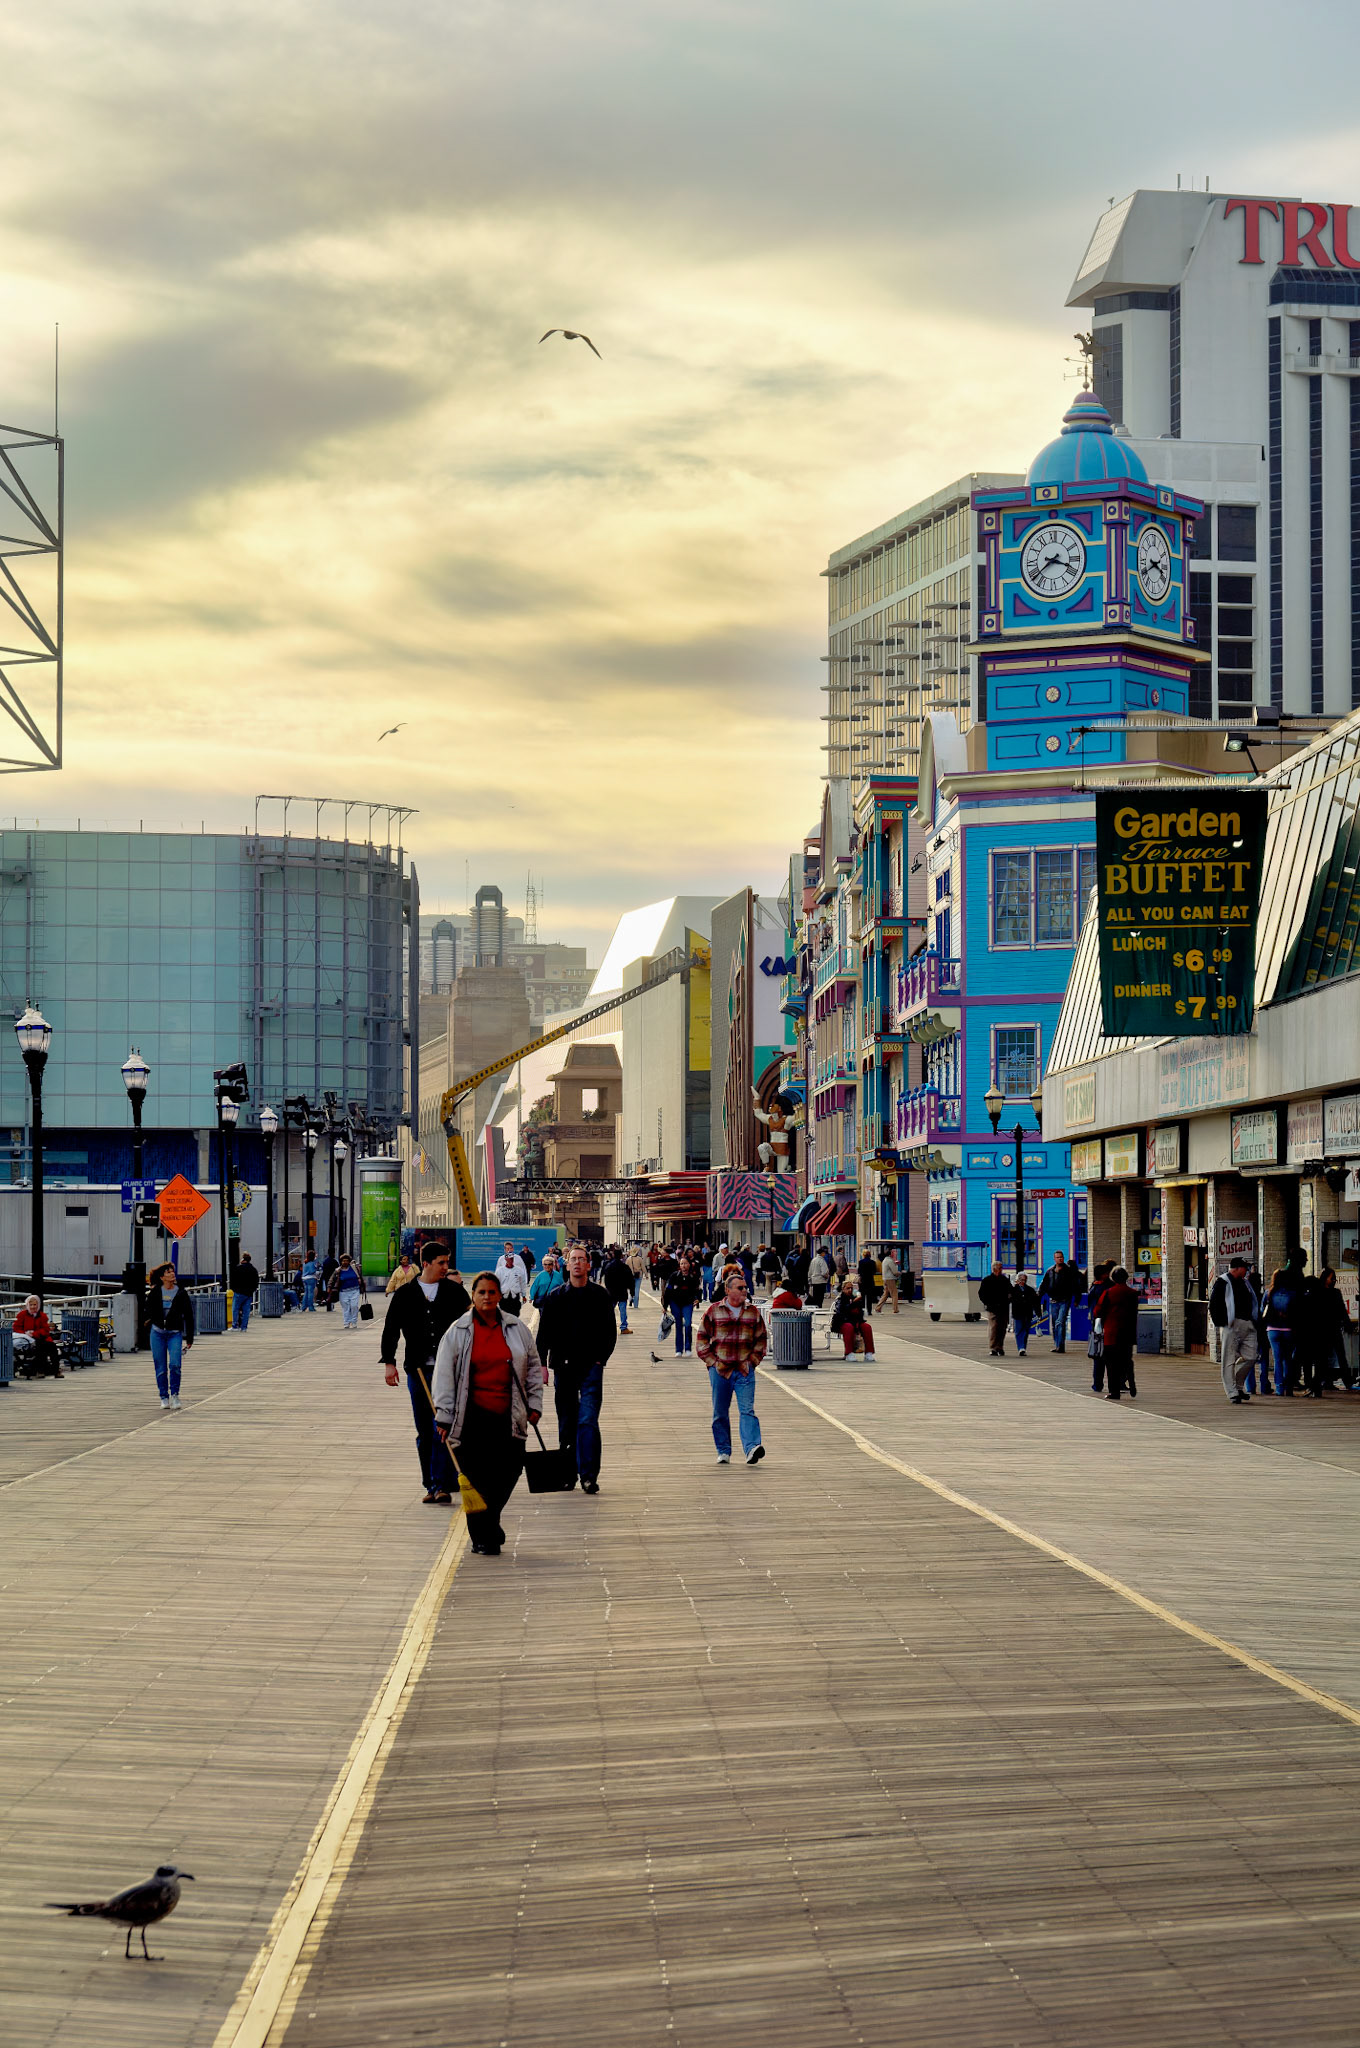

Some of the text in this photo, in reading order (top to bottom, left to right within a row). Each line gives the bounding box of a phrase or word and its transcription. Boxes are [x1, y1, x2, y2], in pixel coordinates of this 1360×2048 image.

[1114, 807, 1241, 838] Garden
[1122, 840, 1231, 862] Terrace
[1104, 862, 1250, 895] BUFFET
[1107, 906, 1249, 921] ALL YOU CAN EAT
[1112, 937, 1166, 952] LUNCH
[1114, 984, 1171, 998] DINNER
[1179, 1057, 1223, 1108] BUFFET
[132, 1187, 145, 1199] H
[1222, 1225, 1251, 1240] Frozen
[1219, 1238, 1253, 1255] Custard
